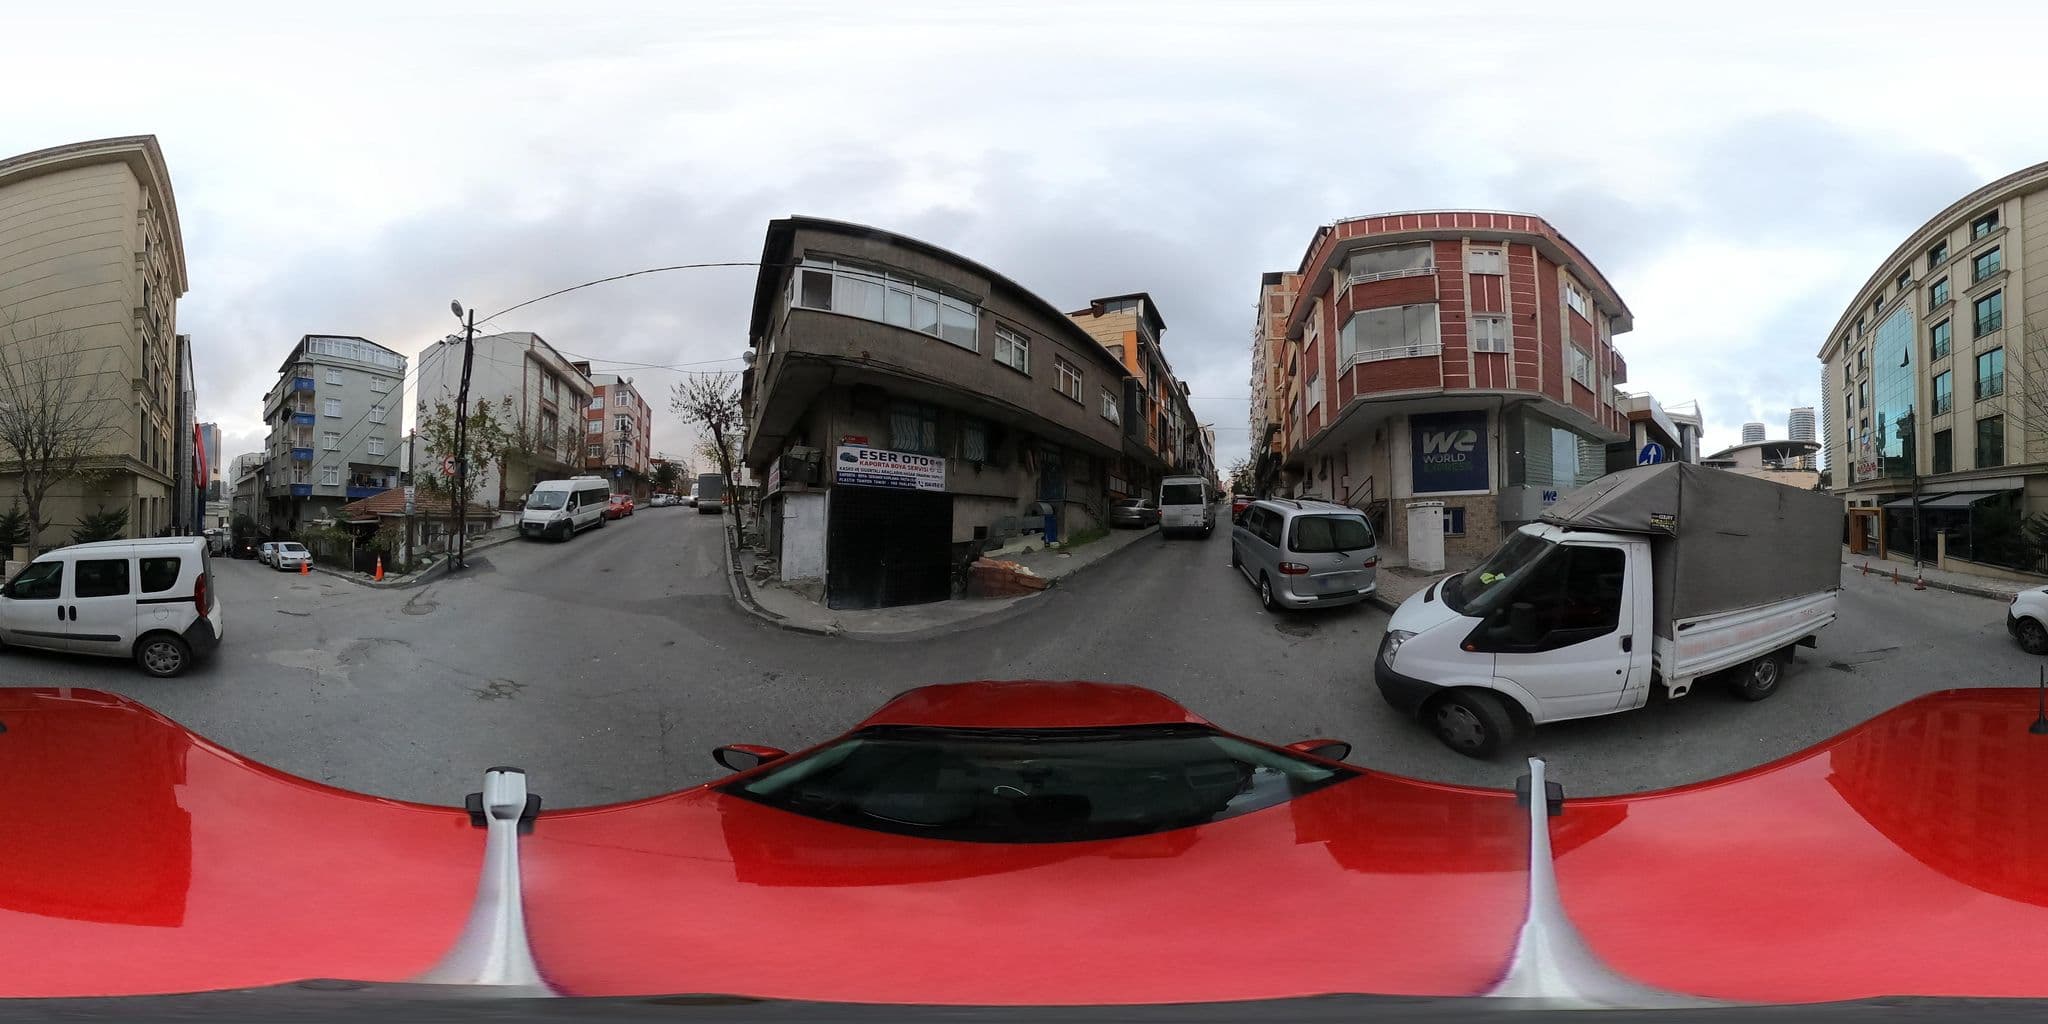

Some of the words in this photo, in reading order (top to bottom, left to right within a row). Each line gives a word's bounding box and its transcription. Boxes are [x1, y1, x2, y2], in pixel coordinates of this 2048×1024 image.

[860, 450, 898, 463] ESER
[902, 455, 928, 466] OTO
[1424, 453, 1466, 463] WORLD
[860, 460, 890, 468] KAPORTA
